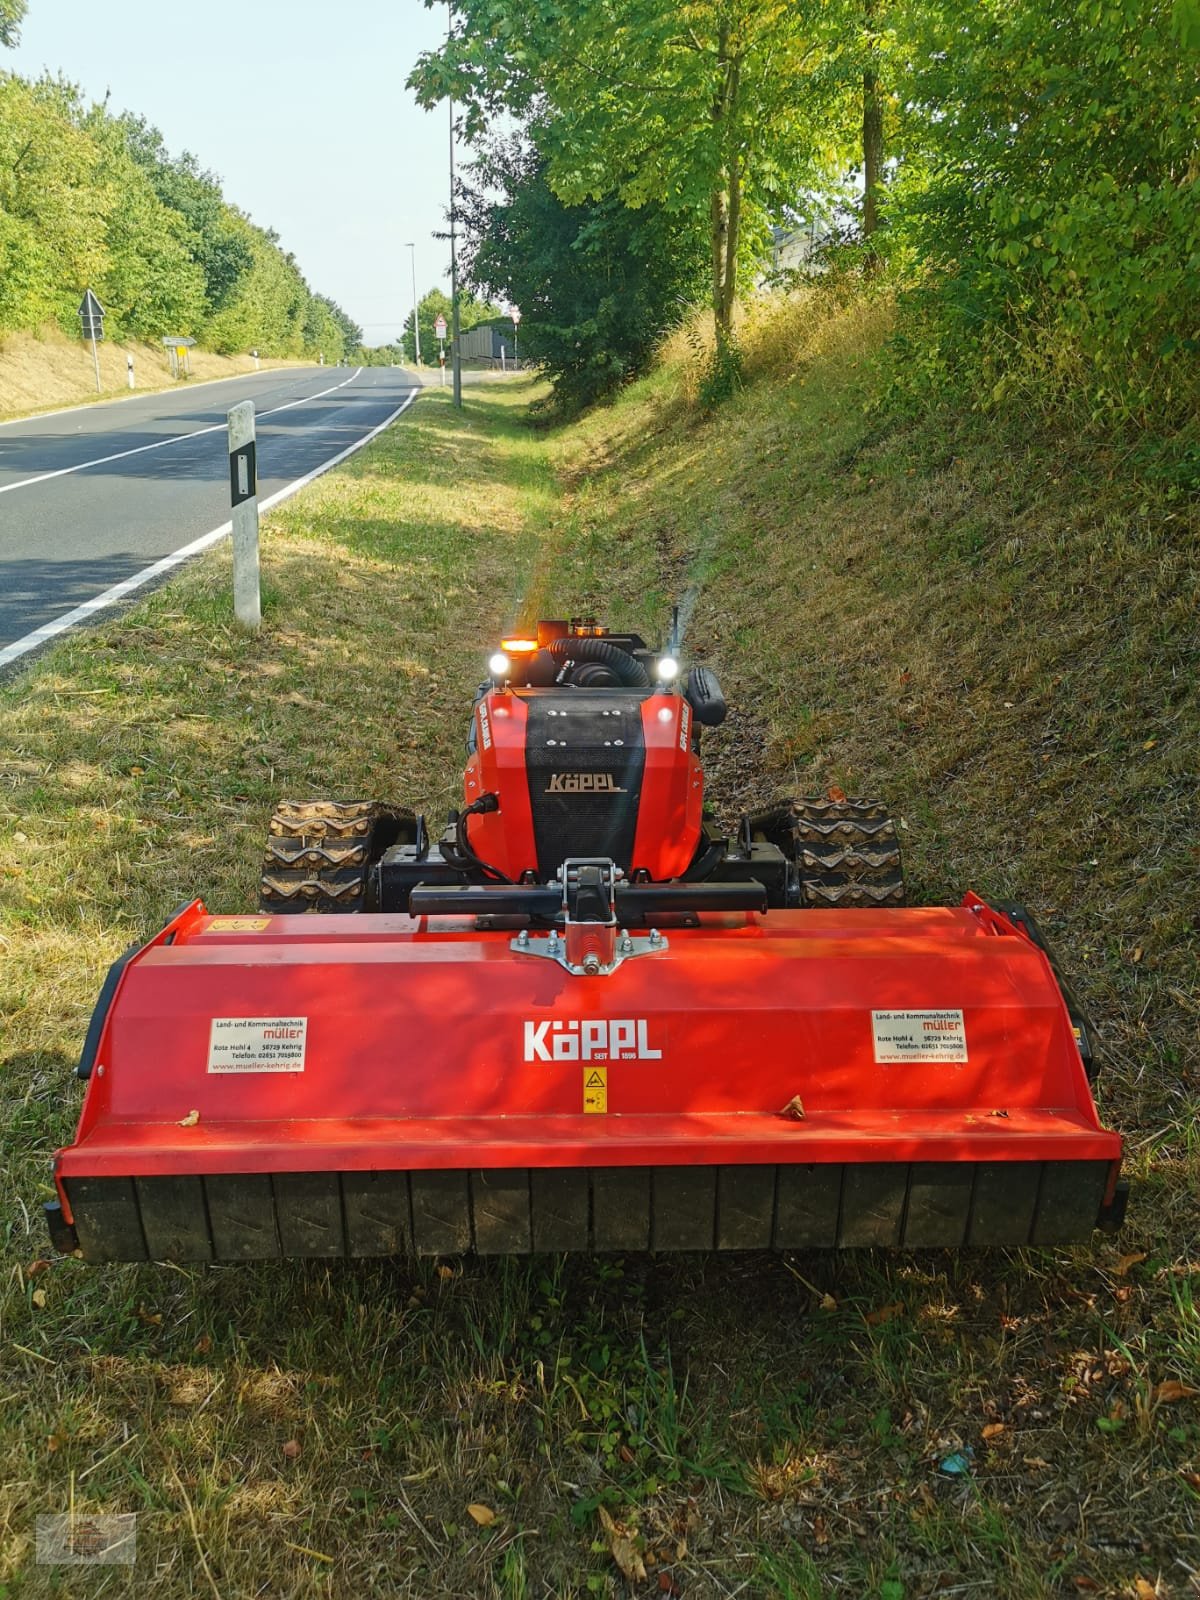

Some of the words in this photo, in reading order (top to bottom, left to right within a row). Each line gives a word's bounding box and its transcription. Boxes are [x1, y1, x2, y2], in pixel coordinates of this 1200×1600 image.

[248, 1020, 303, 1028] Kommunaltechnik
[923, 1020, 961, 1030] müller
[263, 1028, 303, 1039] müller
[524, 1019, 662, 1061] KÖPPL
[281, 1043, 302, 1051] Kehrig
